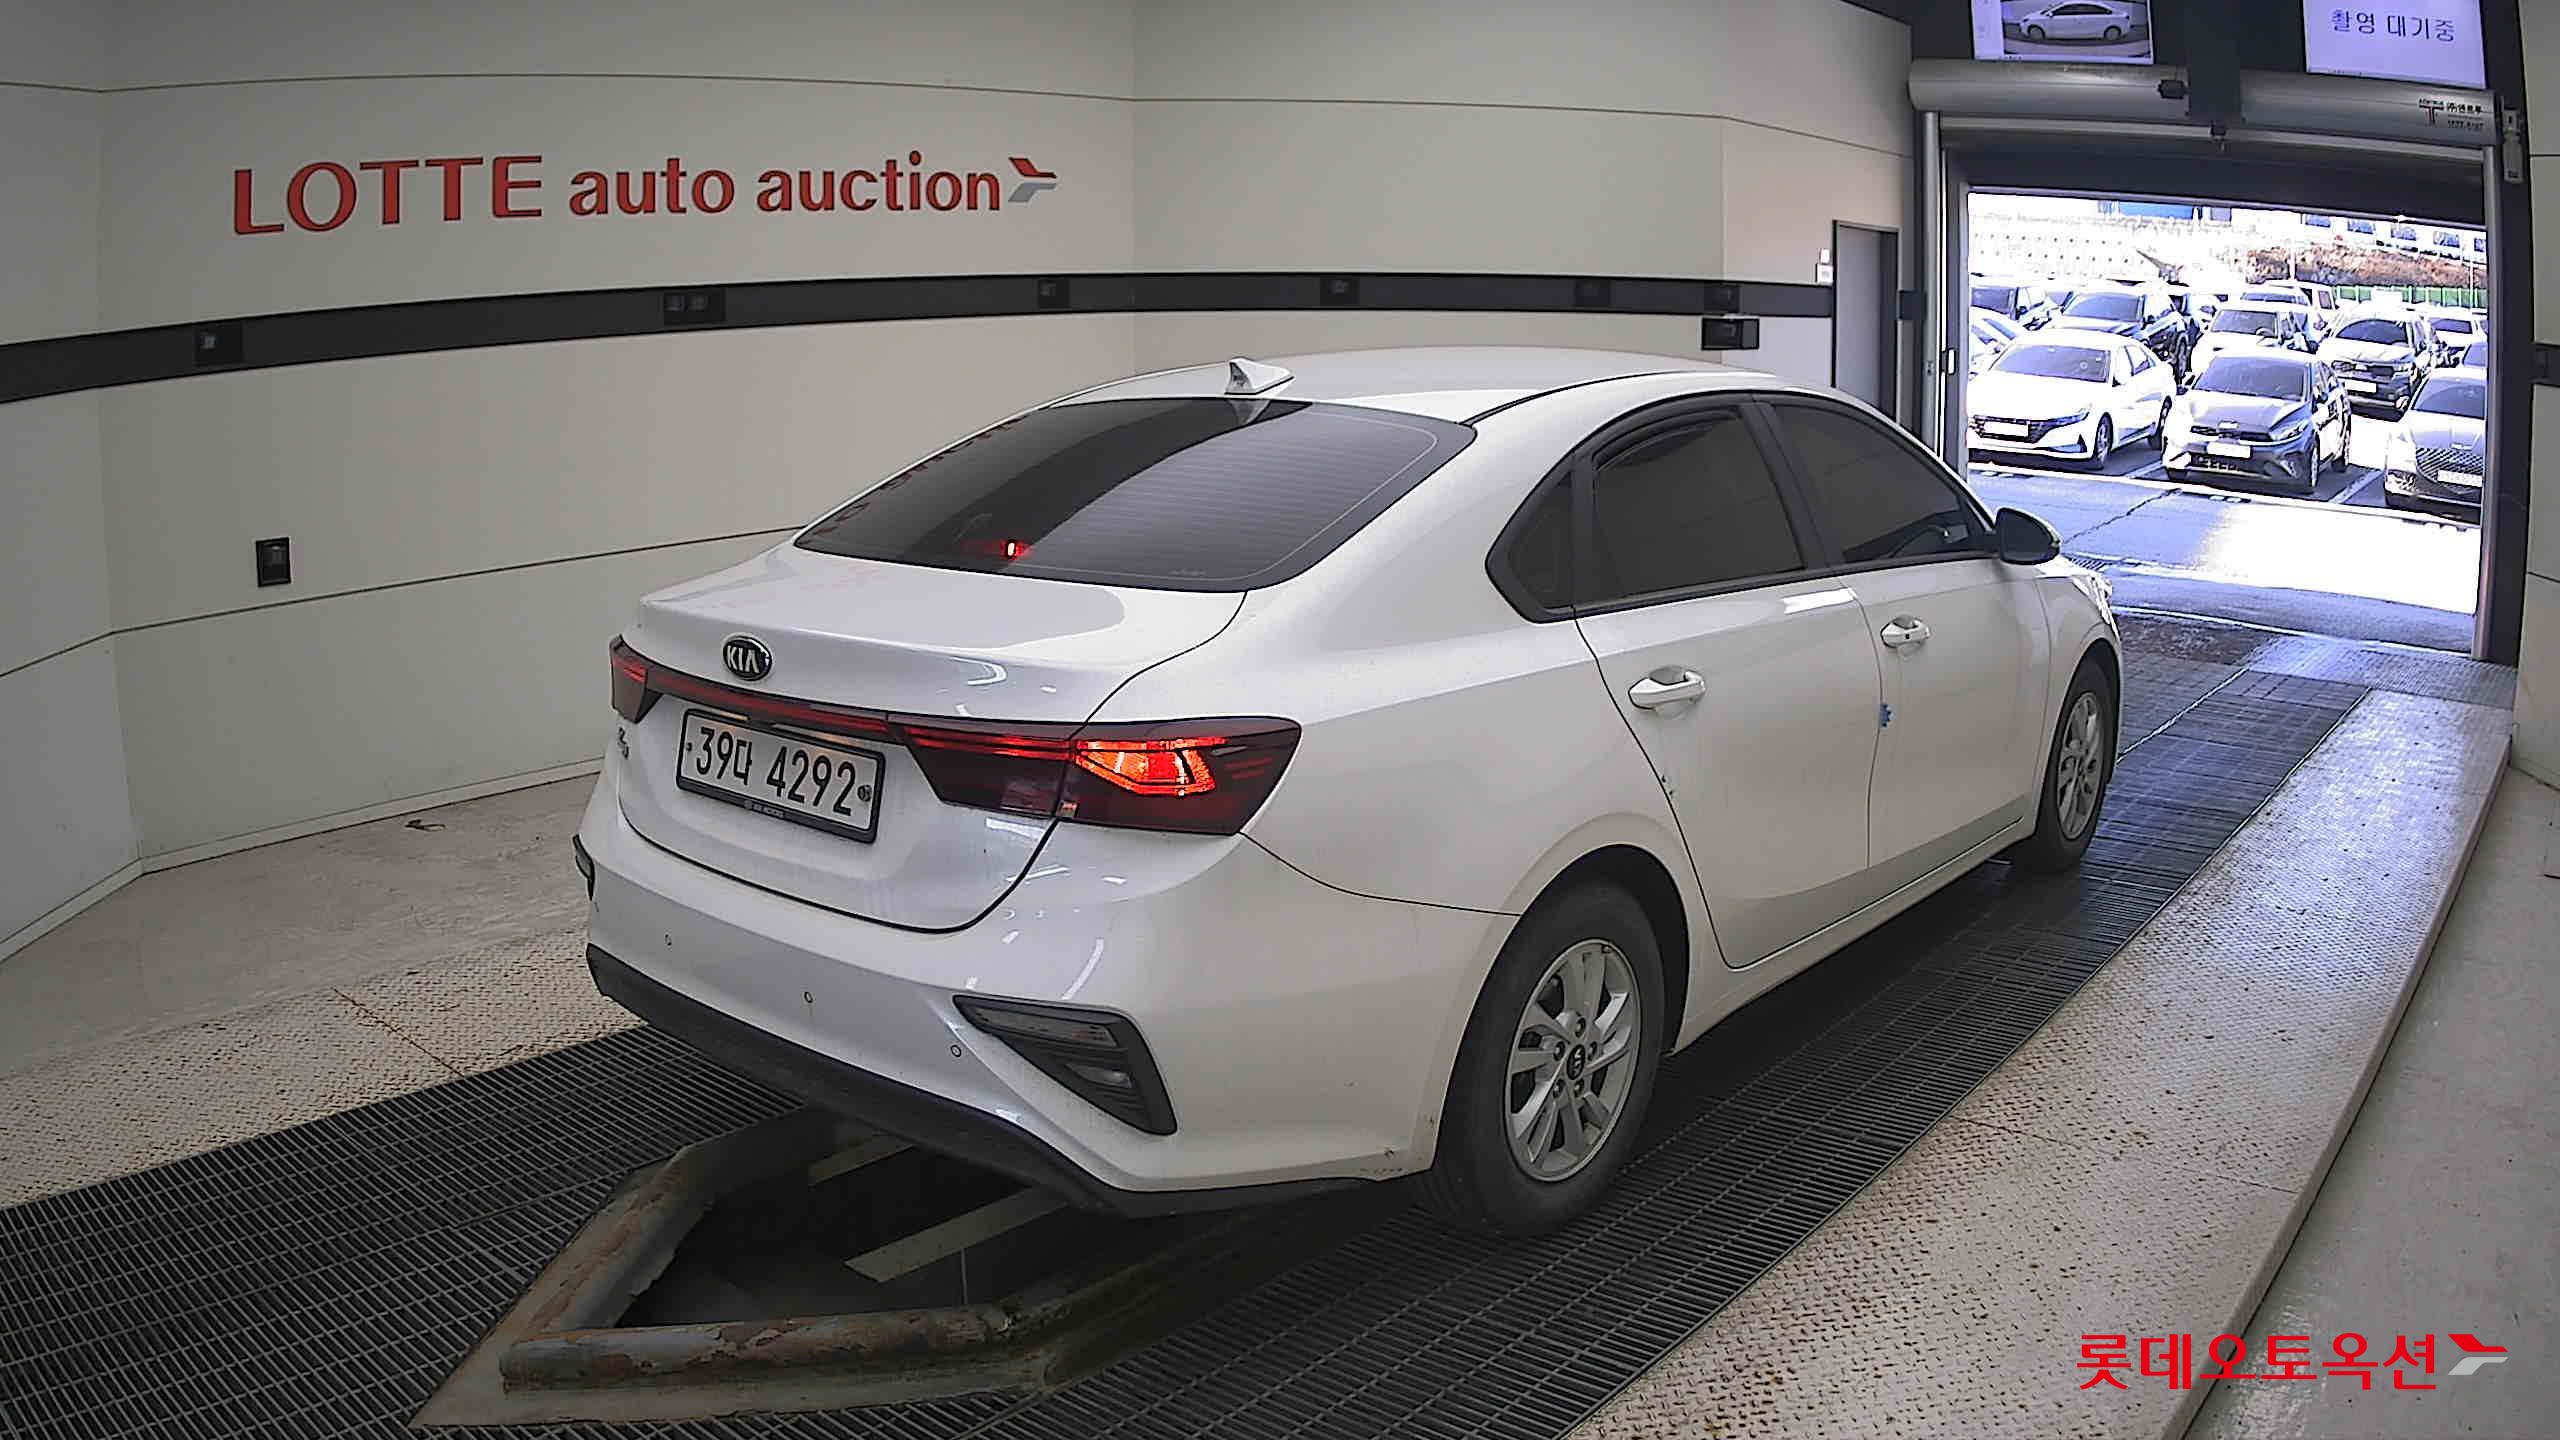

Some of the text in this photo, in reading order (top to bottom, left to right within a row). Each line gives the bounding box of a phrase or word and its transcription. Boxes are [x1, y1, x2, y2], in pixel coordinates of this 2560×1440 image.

[2331, 9, 2456, 43] 촬영 대기중
[233, 150, 1002, 235] LOTTE auto auction
[726, 644, 760, 675] KIA
[696, 726, 753, 786] 39다
[766, 746, 856, 816] 4292
